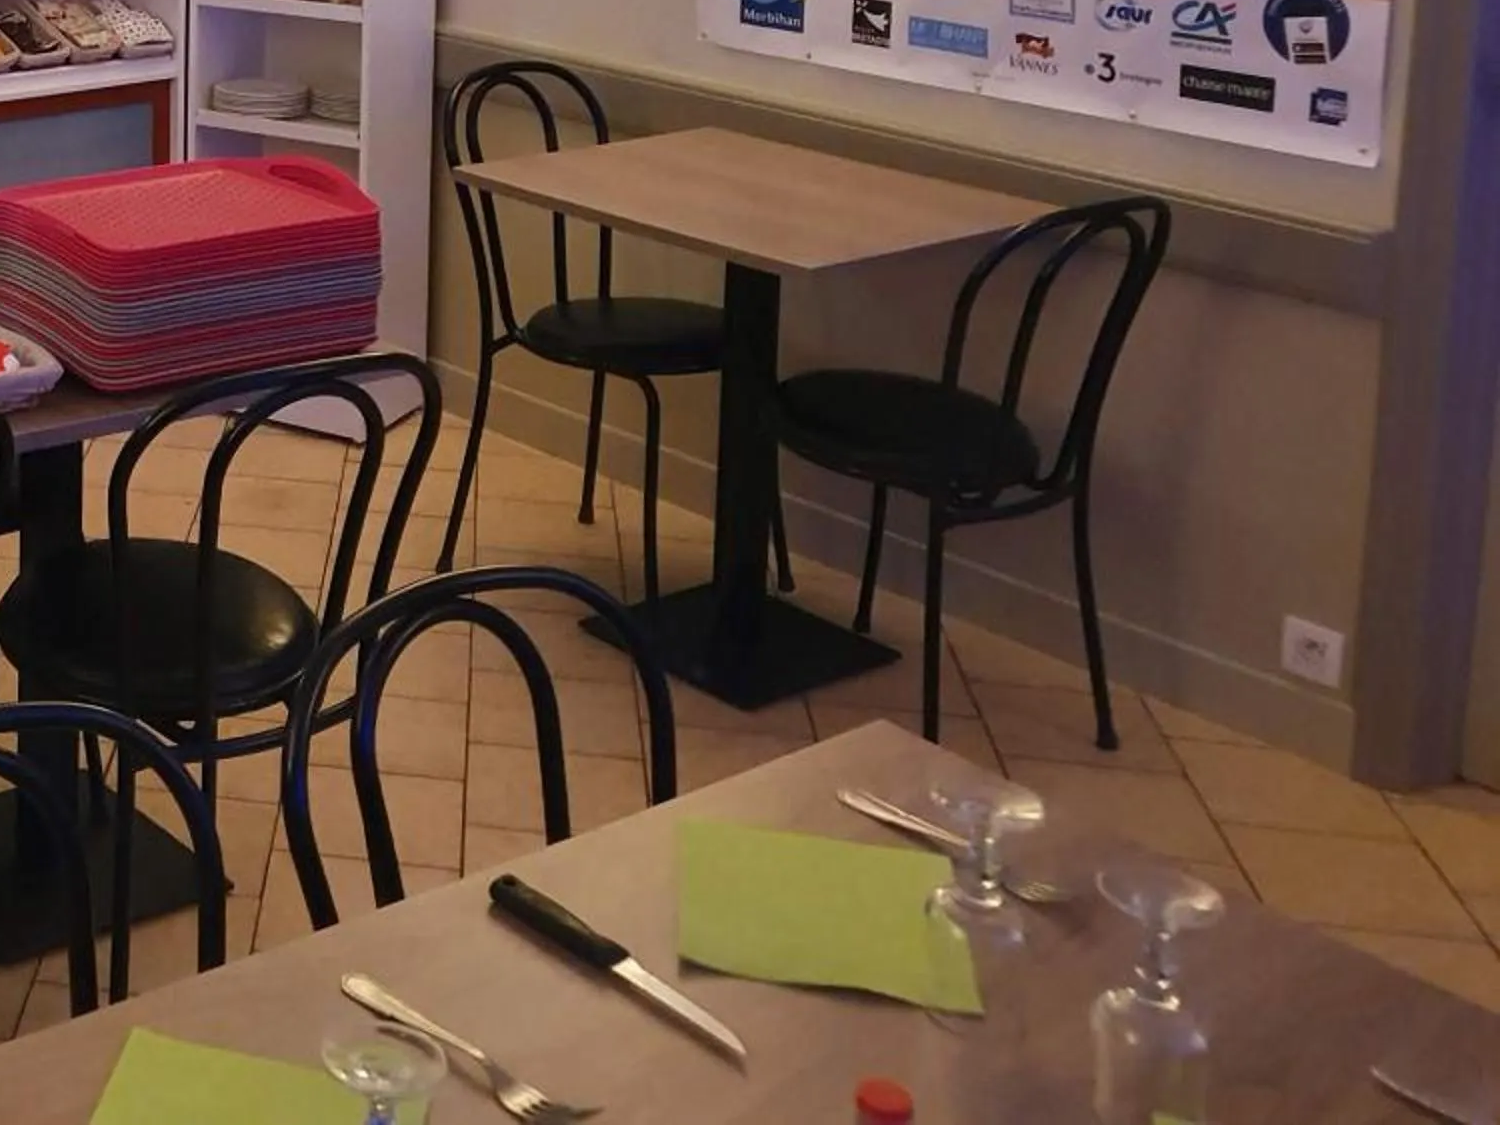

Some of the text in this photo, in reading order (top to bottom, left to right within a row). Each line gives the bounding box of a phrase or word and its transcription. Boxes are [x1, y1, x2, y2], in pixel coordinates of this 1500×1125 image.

[743, 7, 801, 27] Morbihan
[1105, 4, 1153, 25] saur
[1096, 52, 1117, 83] 3
